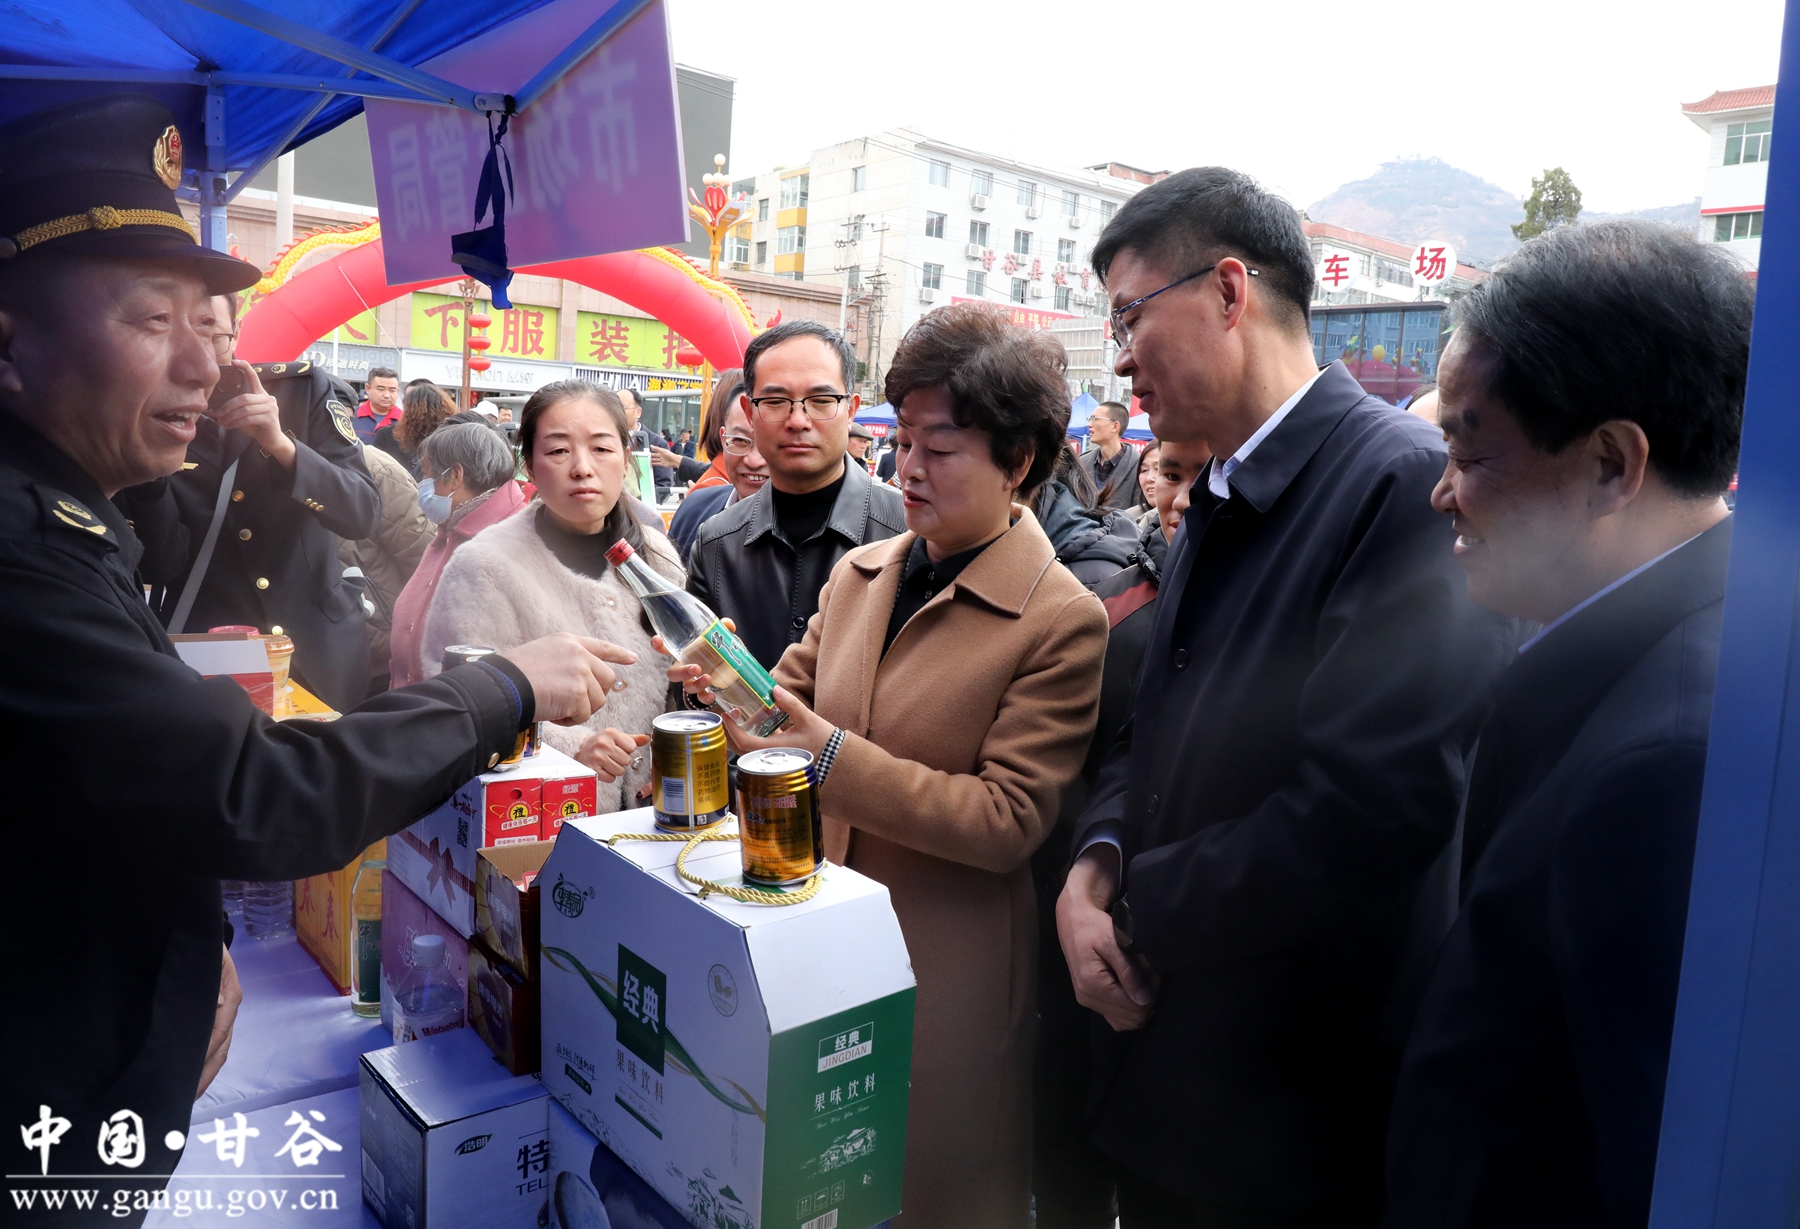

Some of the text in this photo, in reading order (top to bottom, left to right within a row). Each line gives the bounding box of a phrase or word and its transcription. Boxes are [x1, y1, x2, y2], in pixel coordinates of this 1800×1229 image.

[980, 249, 1104, 292] 甘谷县教育
[623, 969, 659, 1034] 经典
[421, 1021, 460, 1037] Wahaha
[834, 1030, 860, 1052] 经典
[822, 1044, 867, 1069] JINGDIAN
[617, 1049, 663, 1105] 果味饮料
[814, 1072, 876, 1113] 果味饮料
[517, 1139, 549, 1179] 特
[515, 1178, 548, 1196] TEL
